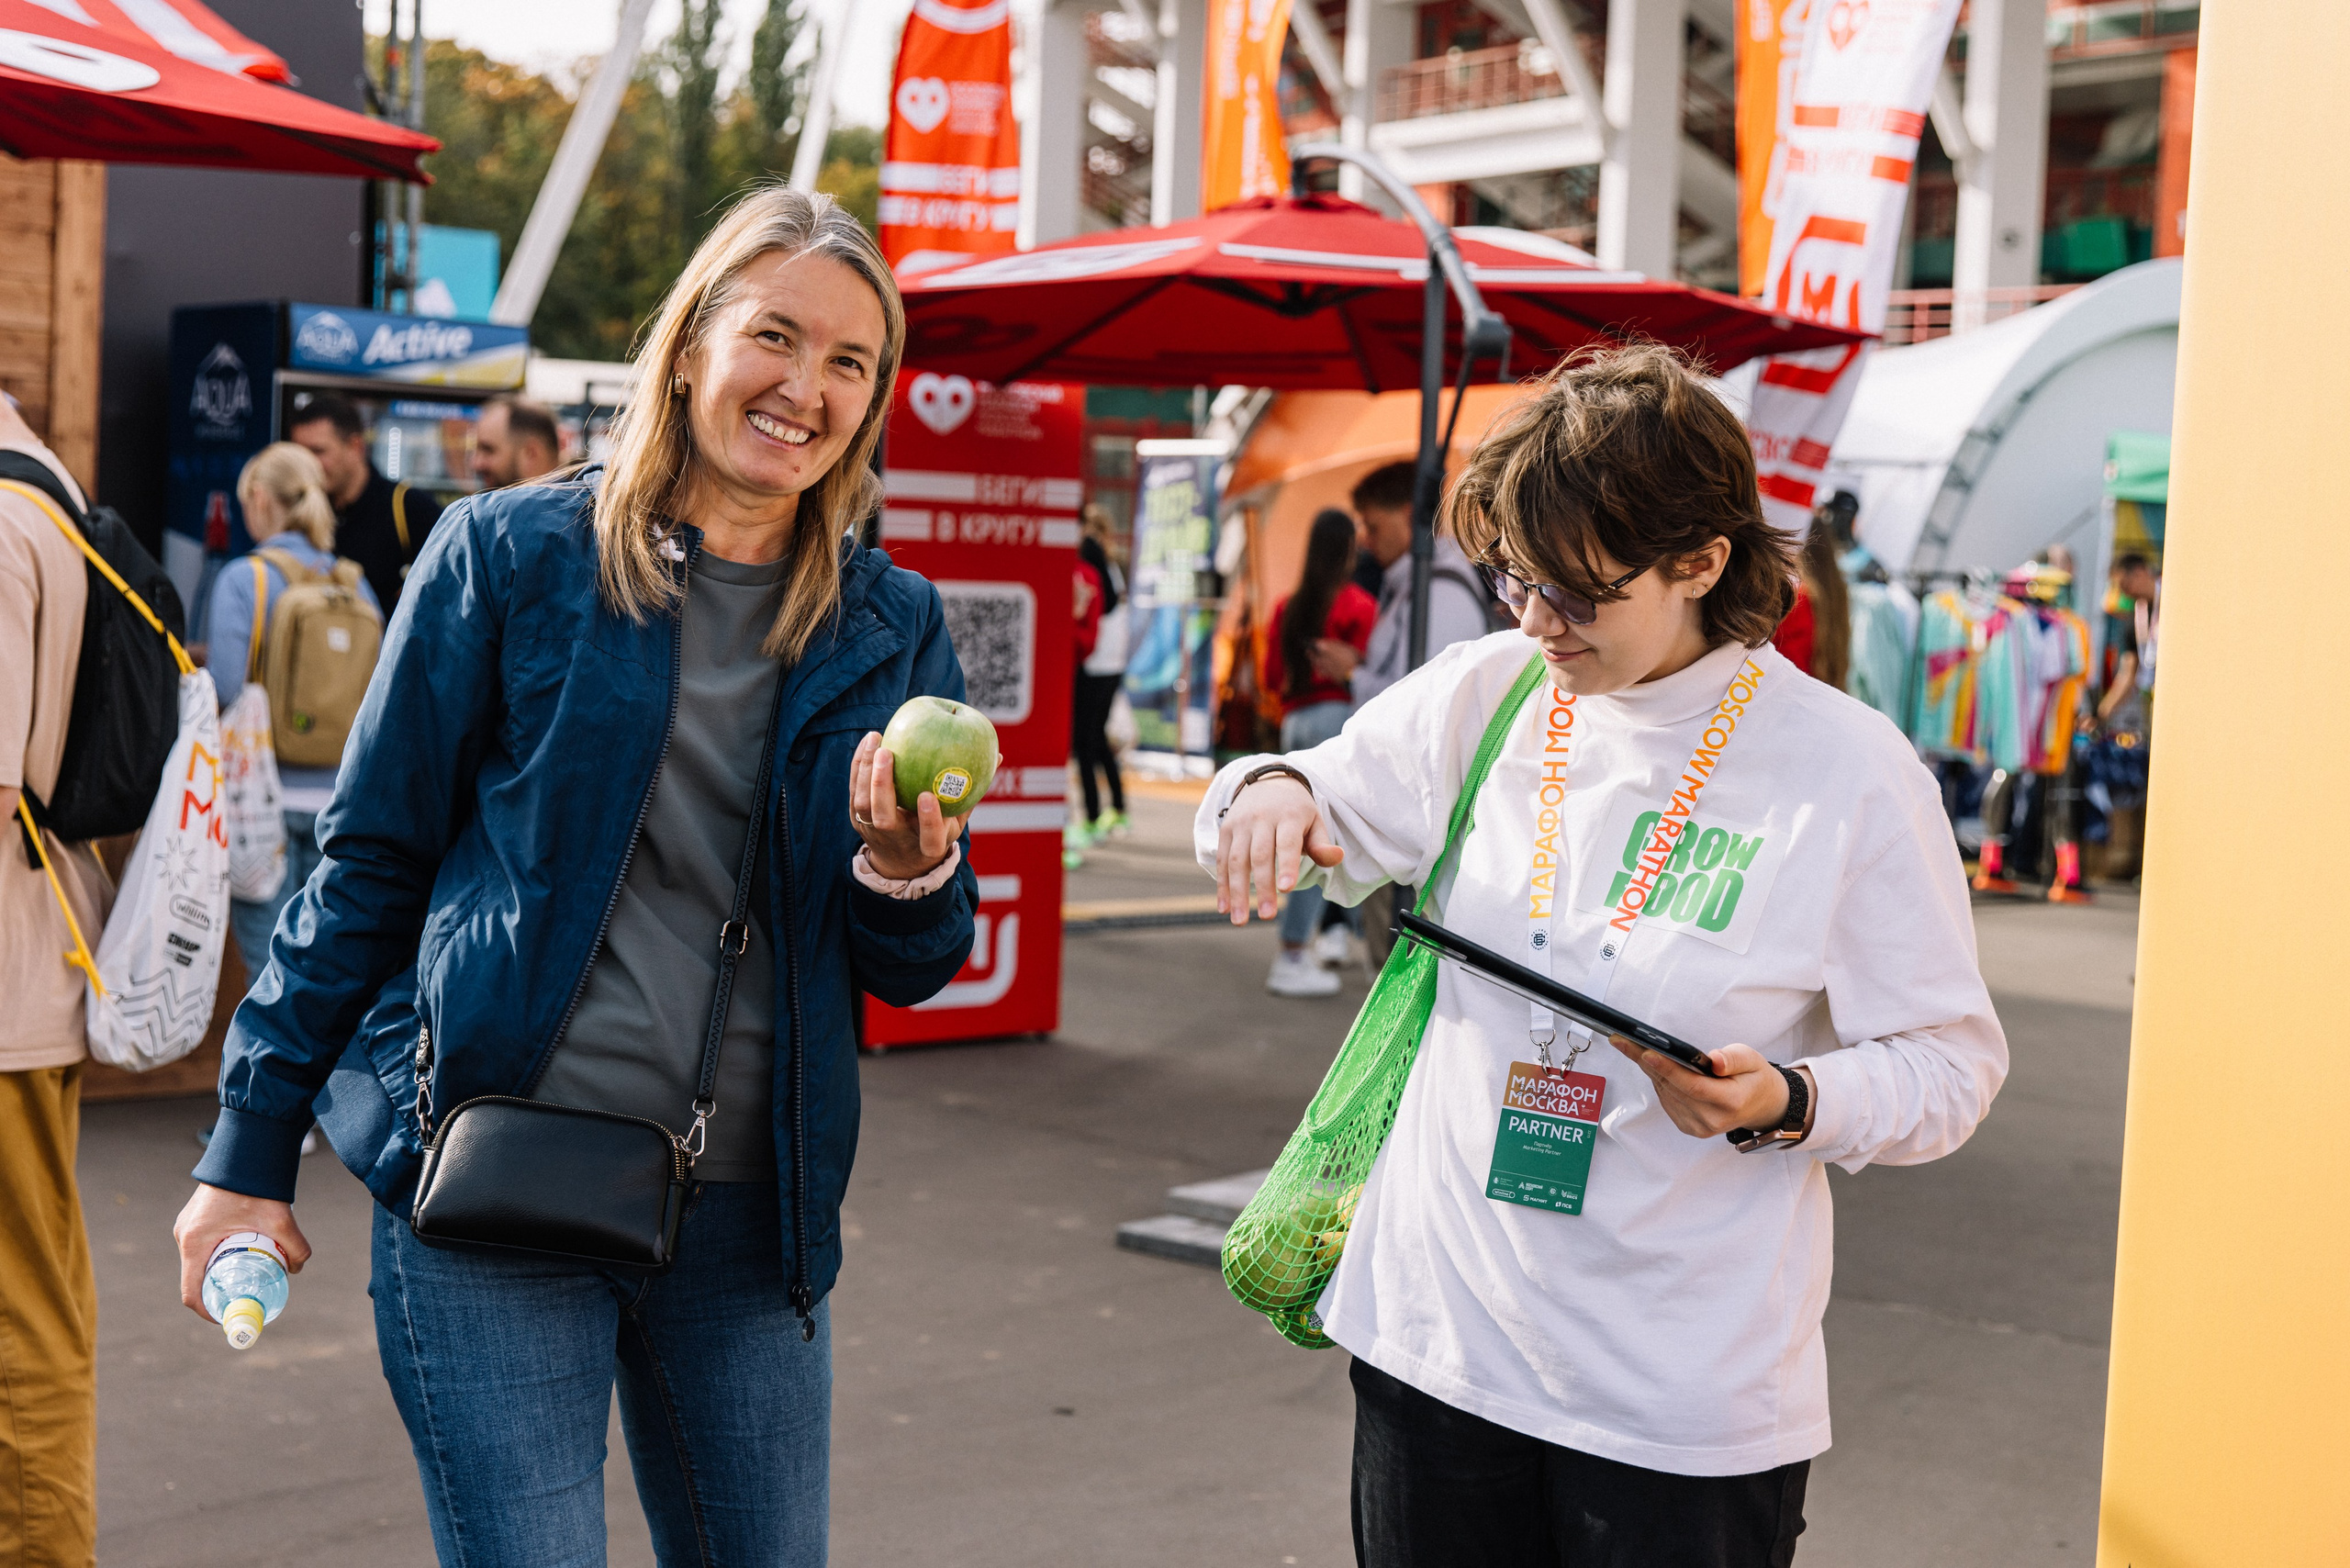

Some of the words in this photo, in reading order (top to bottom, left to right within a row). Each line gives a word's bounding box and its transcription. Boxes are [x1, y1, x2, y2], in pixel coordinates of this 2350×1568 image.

[362, 320, 474, 365] Active
[1545, 687, 1577, 753] МОС
[1689, 658, 1765, 778] MOSCOW
[1529, 761, 1568, 919] МАРАФОН
[1609, 774, 1706, 933] MARATHON
[1507, 1089, 1580, 1116] МОСКВА
[1511, 1074, 1598, 1103] МАРАФОН
[1508, 1115, 1583, 1144] PARTNER
[1522, 1145, 1544, 1154] Marketing
[1545, 1148, 1562, 1156] Partner
